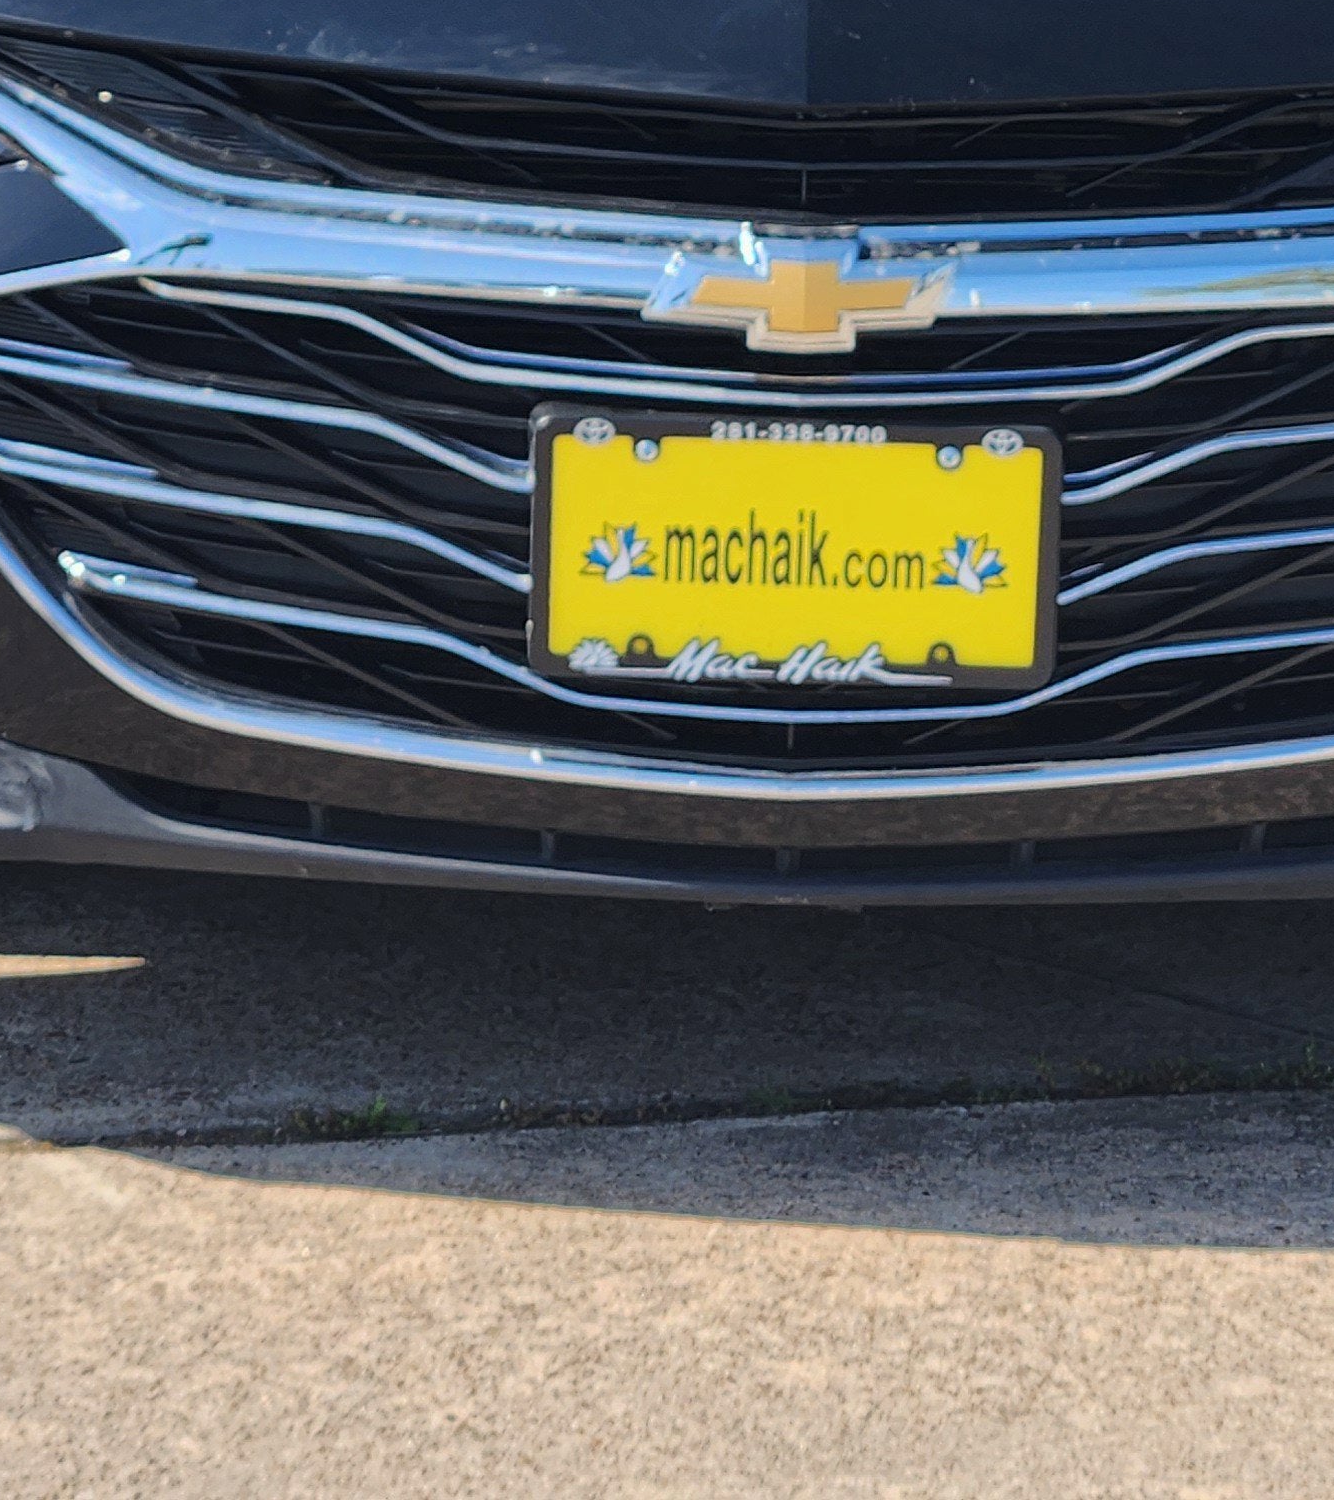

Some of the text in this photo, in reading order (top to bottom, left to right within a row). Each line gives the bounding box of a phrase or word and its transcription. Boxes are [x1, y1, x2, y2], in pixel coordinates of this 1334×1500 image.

[664, 507, 925, 590] machaik.com
[666, 637, 887, 685] Mac Haik
